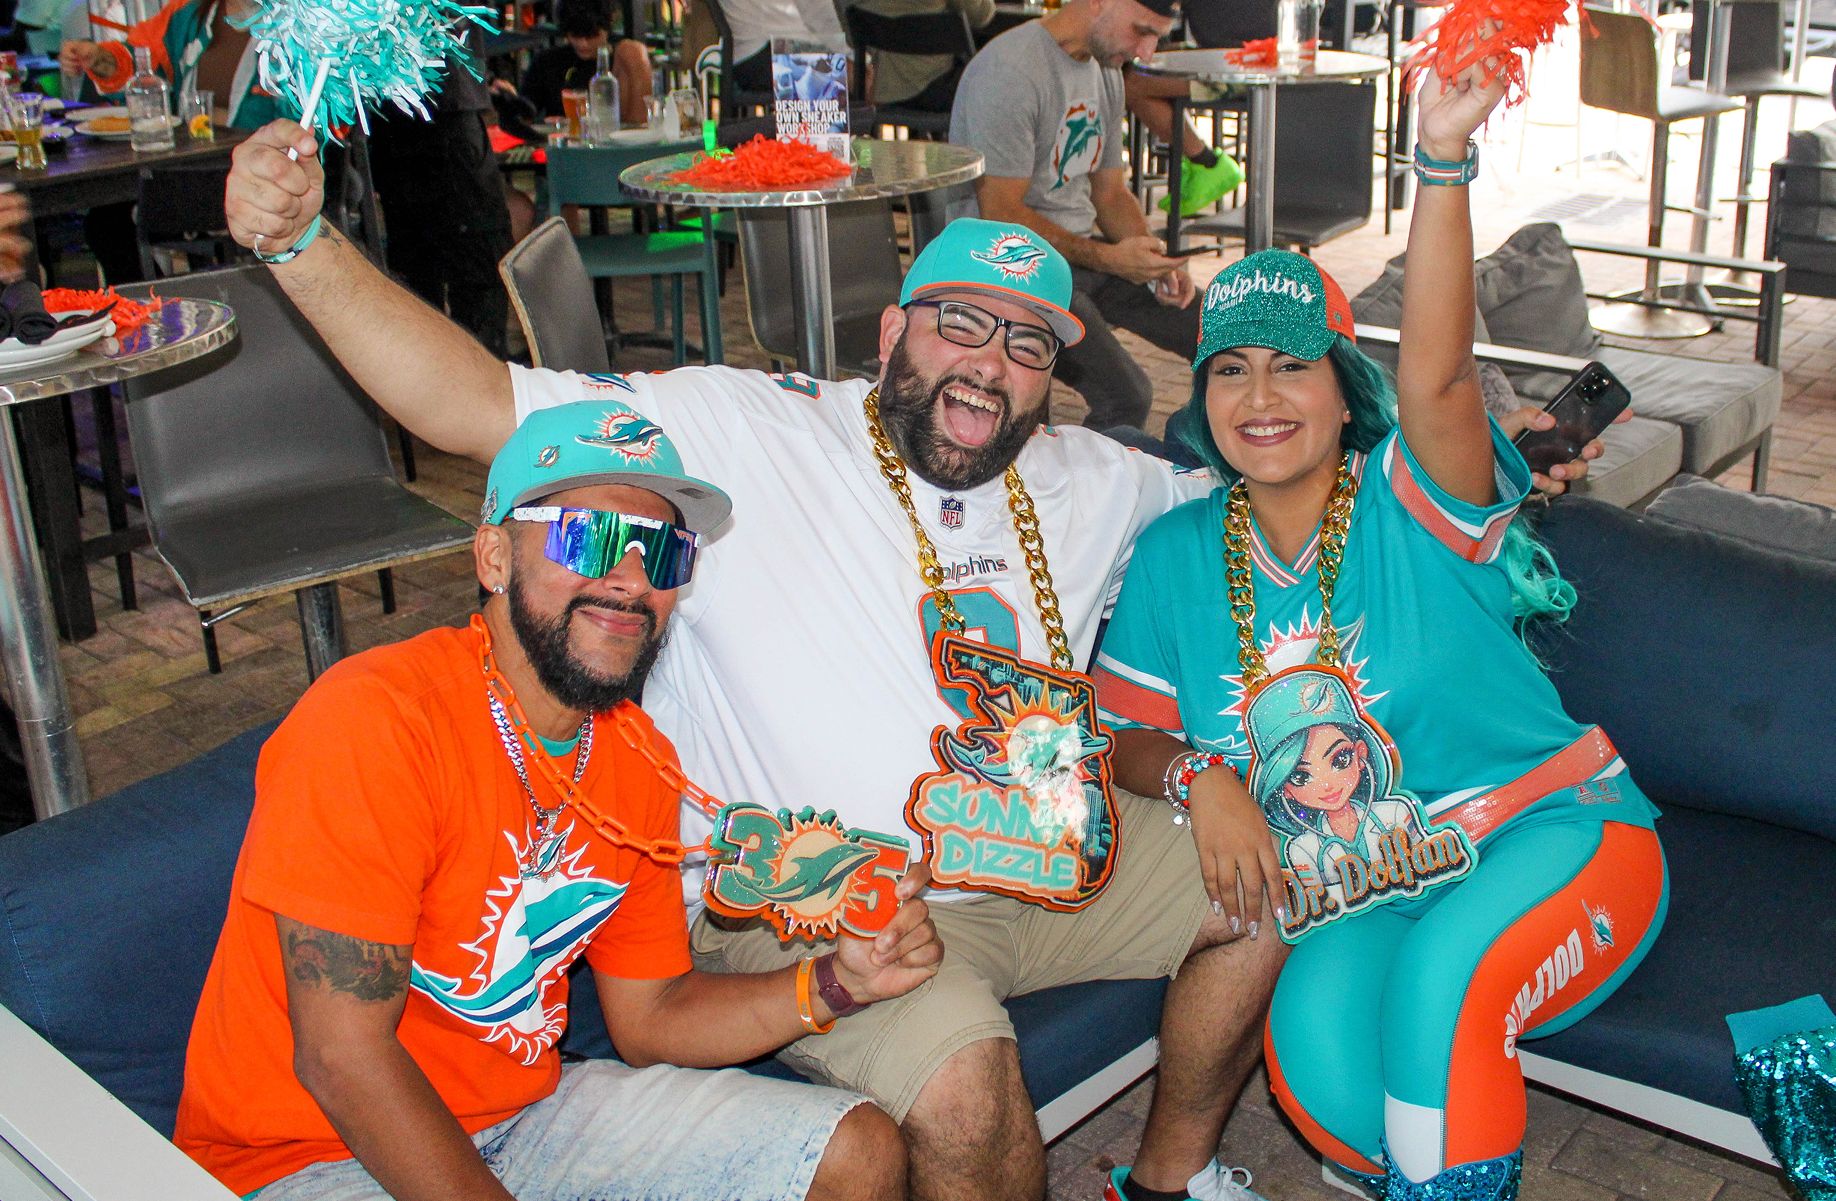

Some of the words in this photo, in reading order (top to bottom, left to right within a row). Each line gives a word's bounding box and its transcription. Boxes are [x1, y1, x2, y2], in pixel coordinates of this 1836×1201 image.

[776, 100, 810, 112] DESIGN
[814, 100, 839, 111] YOUR
[776, 111, 800, 123] OWN
[801, 111, 847, 123] SNEAKER
[1207, 269, 1316, 311] Dolphins
[942, 510, 962, 525] NFL
[942, 555, 1009, 584] olphins
[939, 832, 1077, 889] DIZZLE
[1282, 871, 1337, 929] Dr.
[1335, 826, 1463, 903] Dolfan
